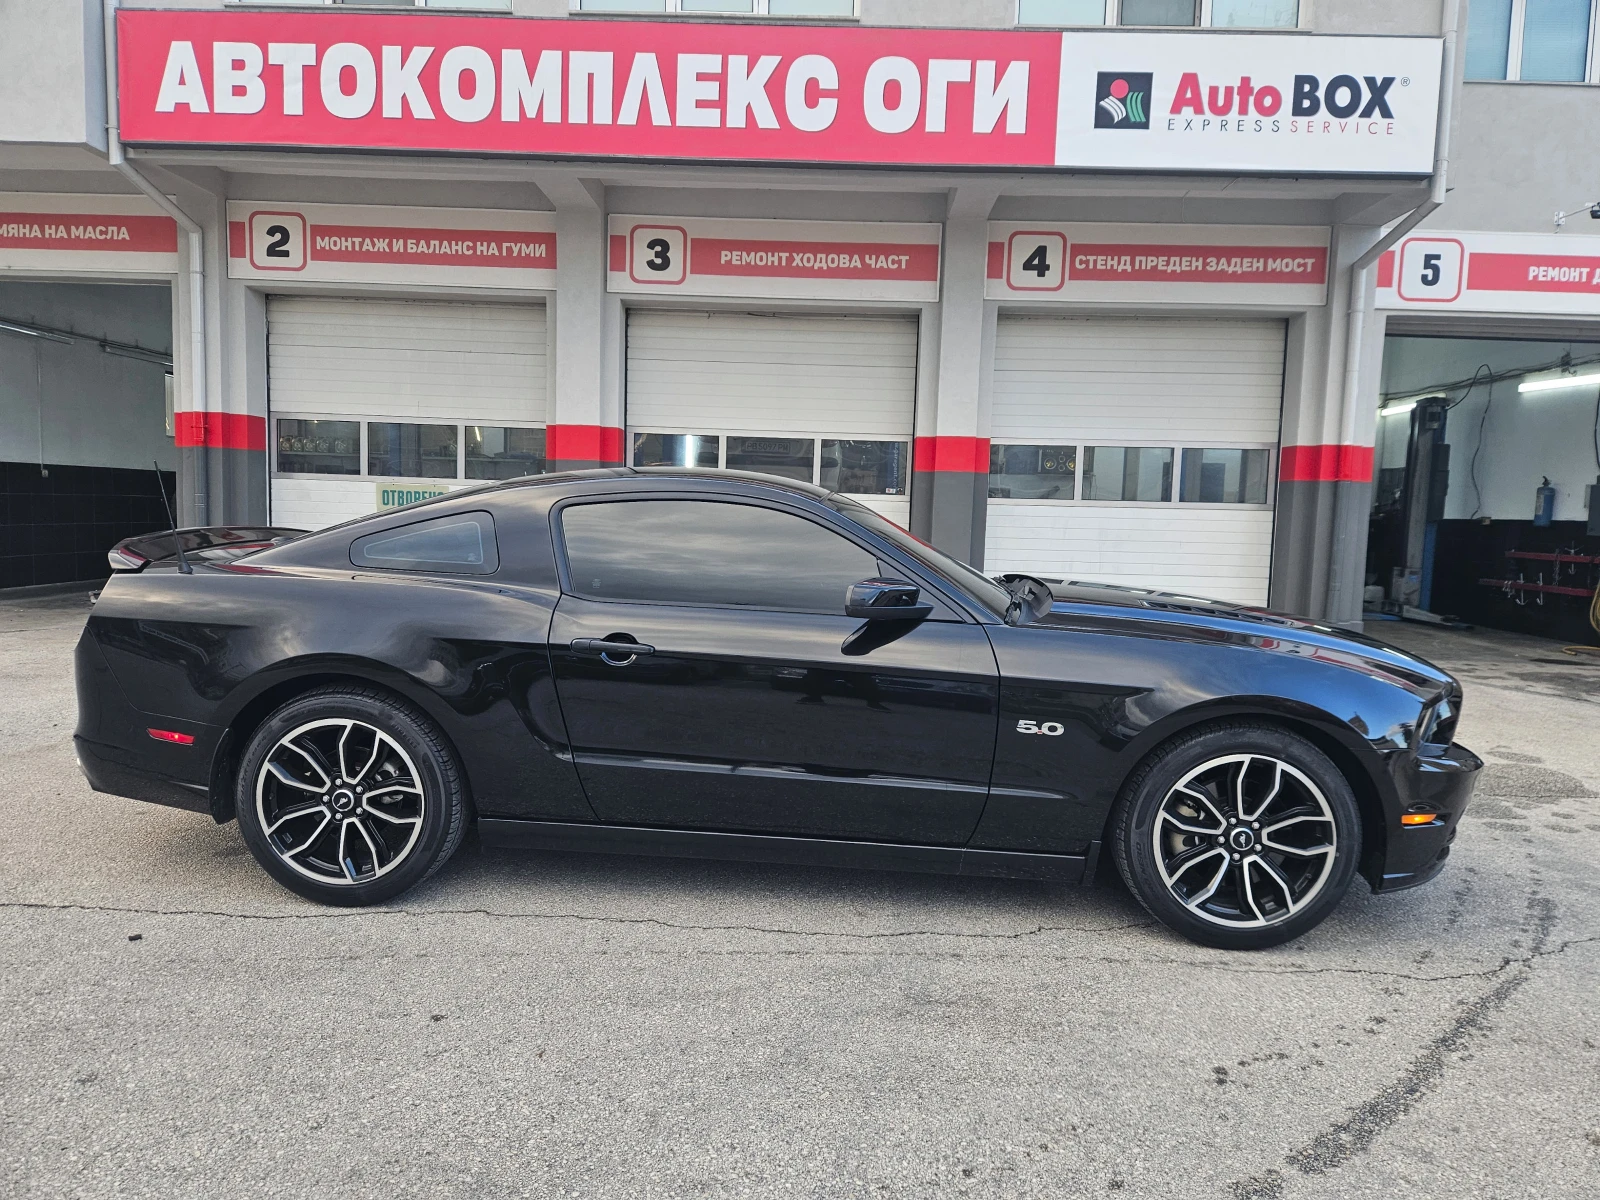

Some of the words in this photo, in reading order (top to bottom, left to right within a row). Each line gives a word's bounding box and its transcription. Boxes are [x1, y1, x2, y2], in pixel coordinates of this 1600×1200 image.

[155, 40, 840, 132] АВТОКОМПЛЕКС
[863, 55, 1030, 135] ОГИ
[1169, 72, 1282, 117] Auto
[1291, 74, 1397, 120] BOX
[1167, 118, 1280, 133] EXPRESS
[1289, 120, 1395, 135] SERVICE
[44, 224, 69, 239] НА
[71, 225, 131, 241] МАСЛА
[265, 224, 291, 258] 2
[316, 235, 390, 252] МОНТАЖ
[392, 238, 404, 253] И
[407, 239, 474, 255] БАЛАНС
[476, 241, 499, 257] НА
[502, 242, 547, 258] ГУМИ
[645, 238, 671, 272] 3
[720, 250, 790, 267] РЕМОНТ
[792, 251, 861, 270] ХОДОВА
[864, 254, 910, 270] ЧАСТ
[1021, 244, 1051, 278] 4
[1074, 254, 1132, 273] СТЕНД
[1134, 255, 1202, 273] ПРЕДЕН
[1206, 256, 1264, 275] ЗАДЕН
[1266, 257, 1316, 273] МОСТ
[1420, 253, 1442, 287] 5
[1528, 265, 1591, 283] РЕМОНТ
[1016, 719, 1065, 736] 5.0
